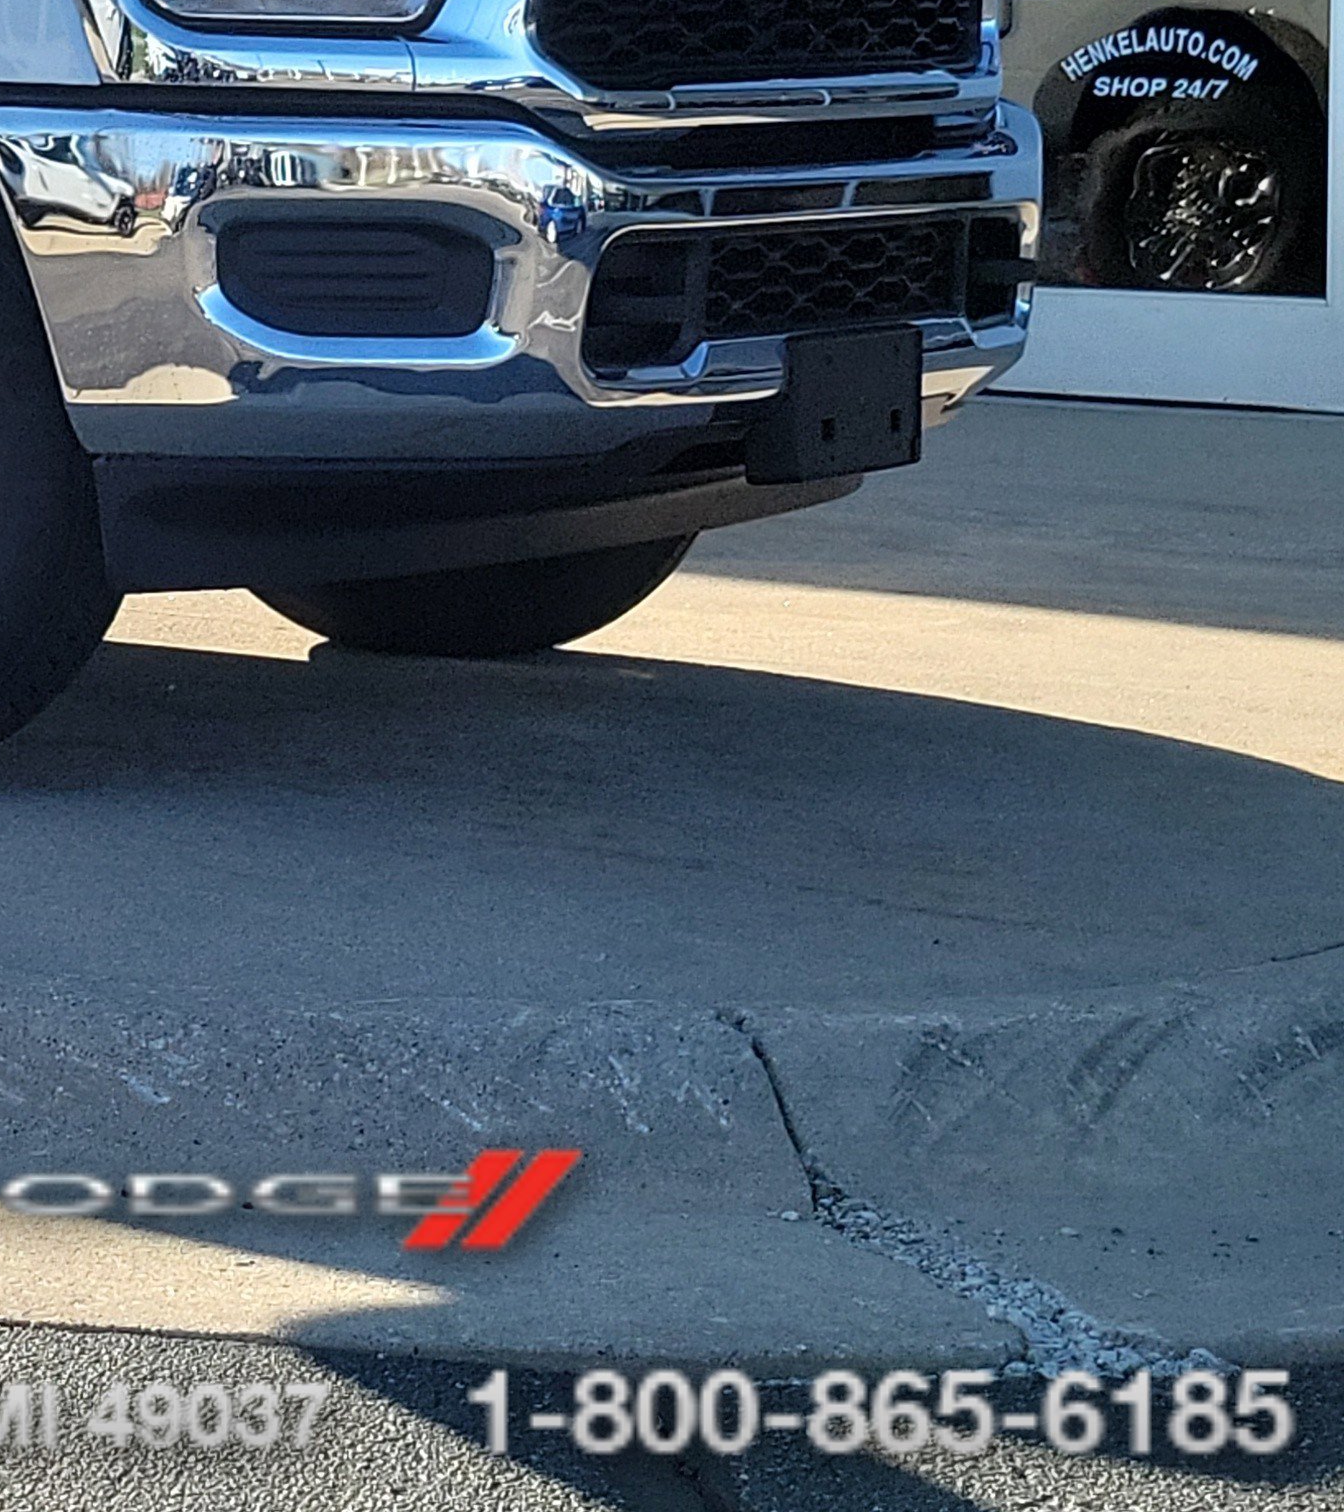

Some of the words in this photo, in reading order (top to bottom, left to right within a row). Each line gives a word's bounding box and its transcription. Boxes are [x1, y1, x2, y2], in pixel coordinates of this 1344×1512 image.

[1061, 27, 1258, 81] HENKELAUTO.COM
[1093, 76, 1166, 98] SHOP
[1172, 78, 1229, 100] 24/7
